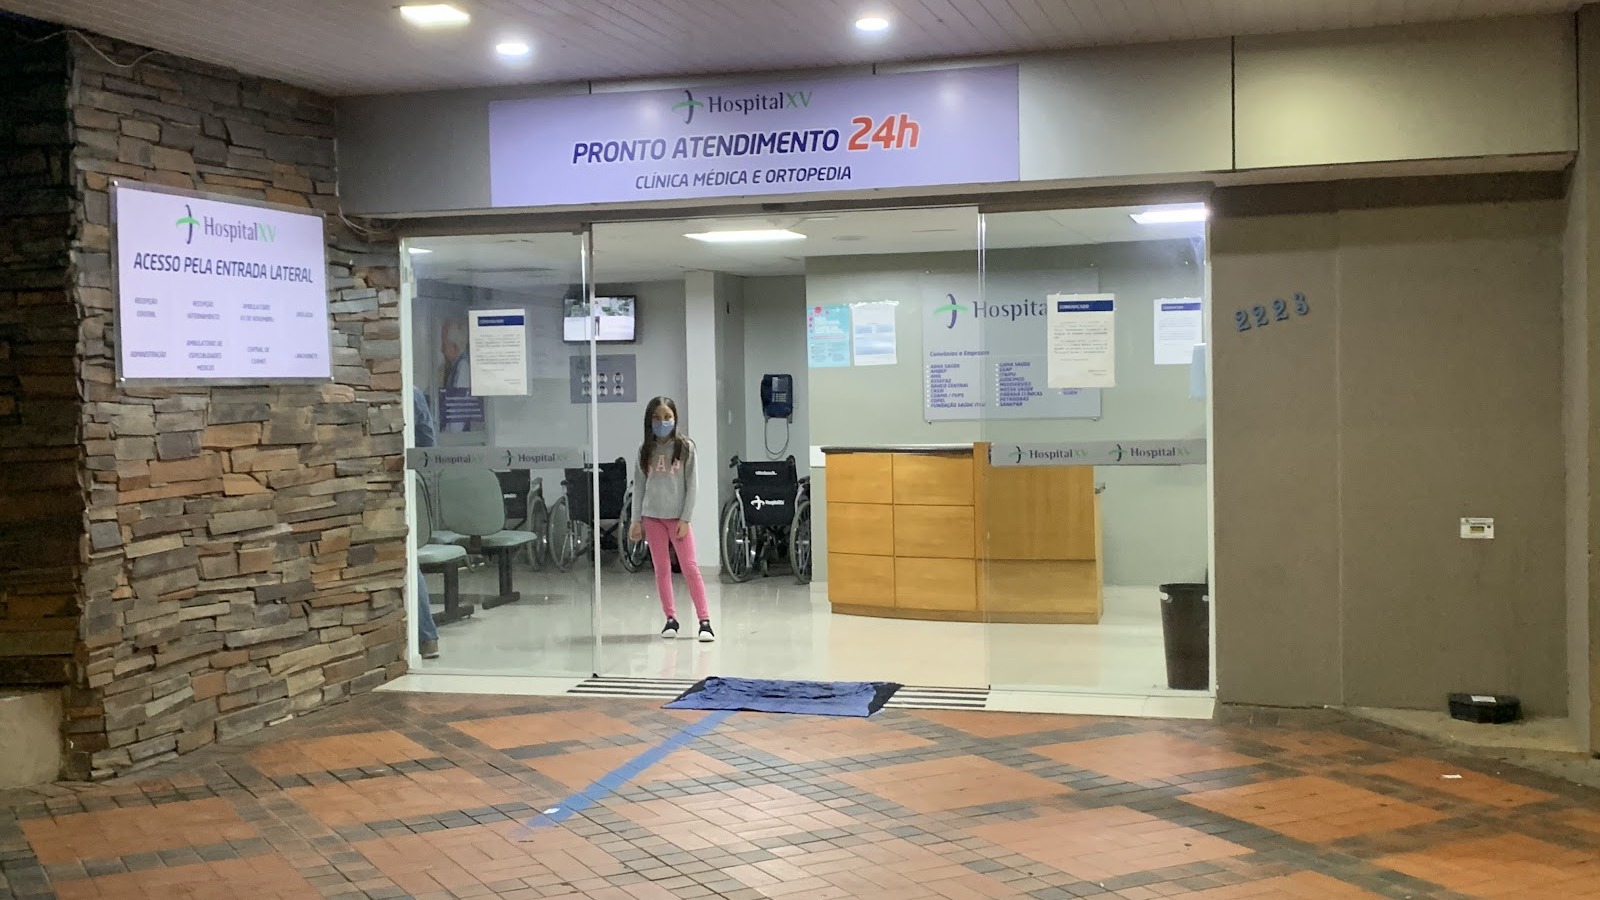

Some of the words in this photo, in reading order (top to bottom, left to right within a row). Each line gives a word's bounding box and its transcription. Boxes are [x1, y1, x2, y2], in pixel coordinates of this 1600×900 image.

[573, 139, 667, 164] PRONTO
[672, 129, 840, 159] ATENDIMENTO
[848, 114, 919, 151] 24h
[635, 172, 688, 189] CLÍNICA
[693, 169, 747, 186] MÉDICA
[752, 169, 762, 184] E
[765, 166, 851, 183] ORTOPEDIA
[133, 252, 181, 273] ACESSO
[184, 256, 213, 275] PELA
[216, 259, 267, 280] ENTRADA
[270, 265, 314, 283] LATERAL
[1235, 291, 1309, 332] 2223
